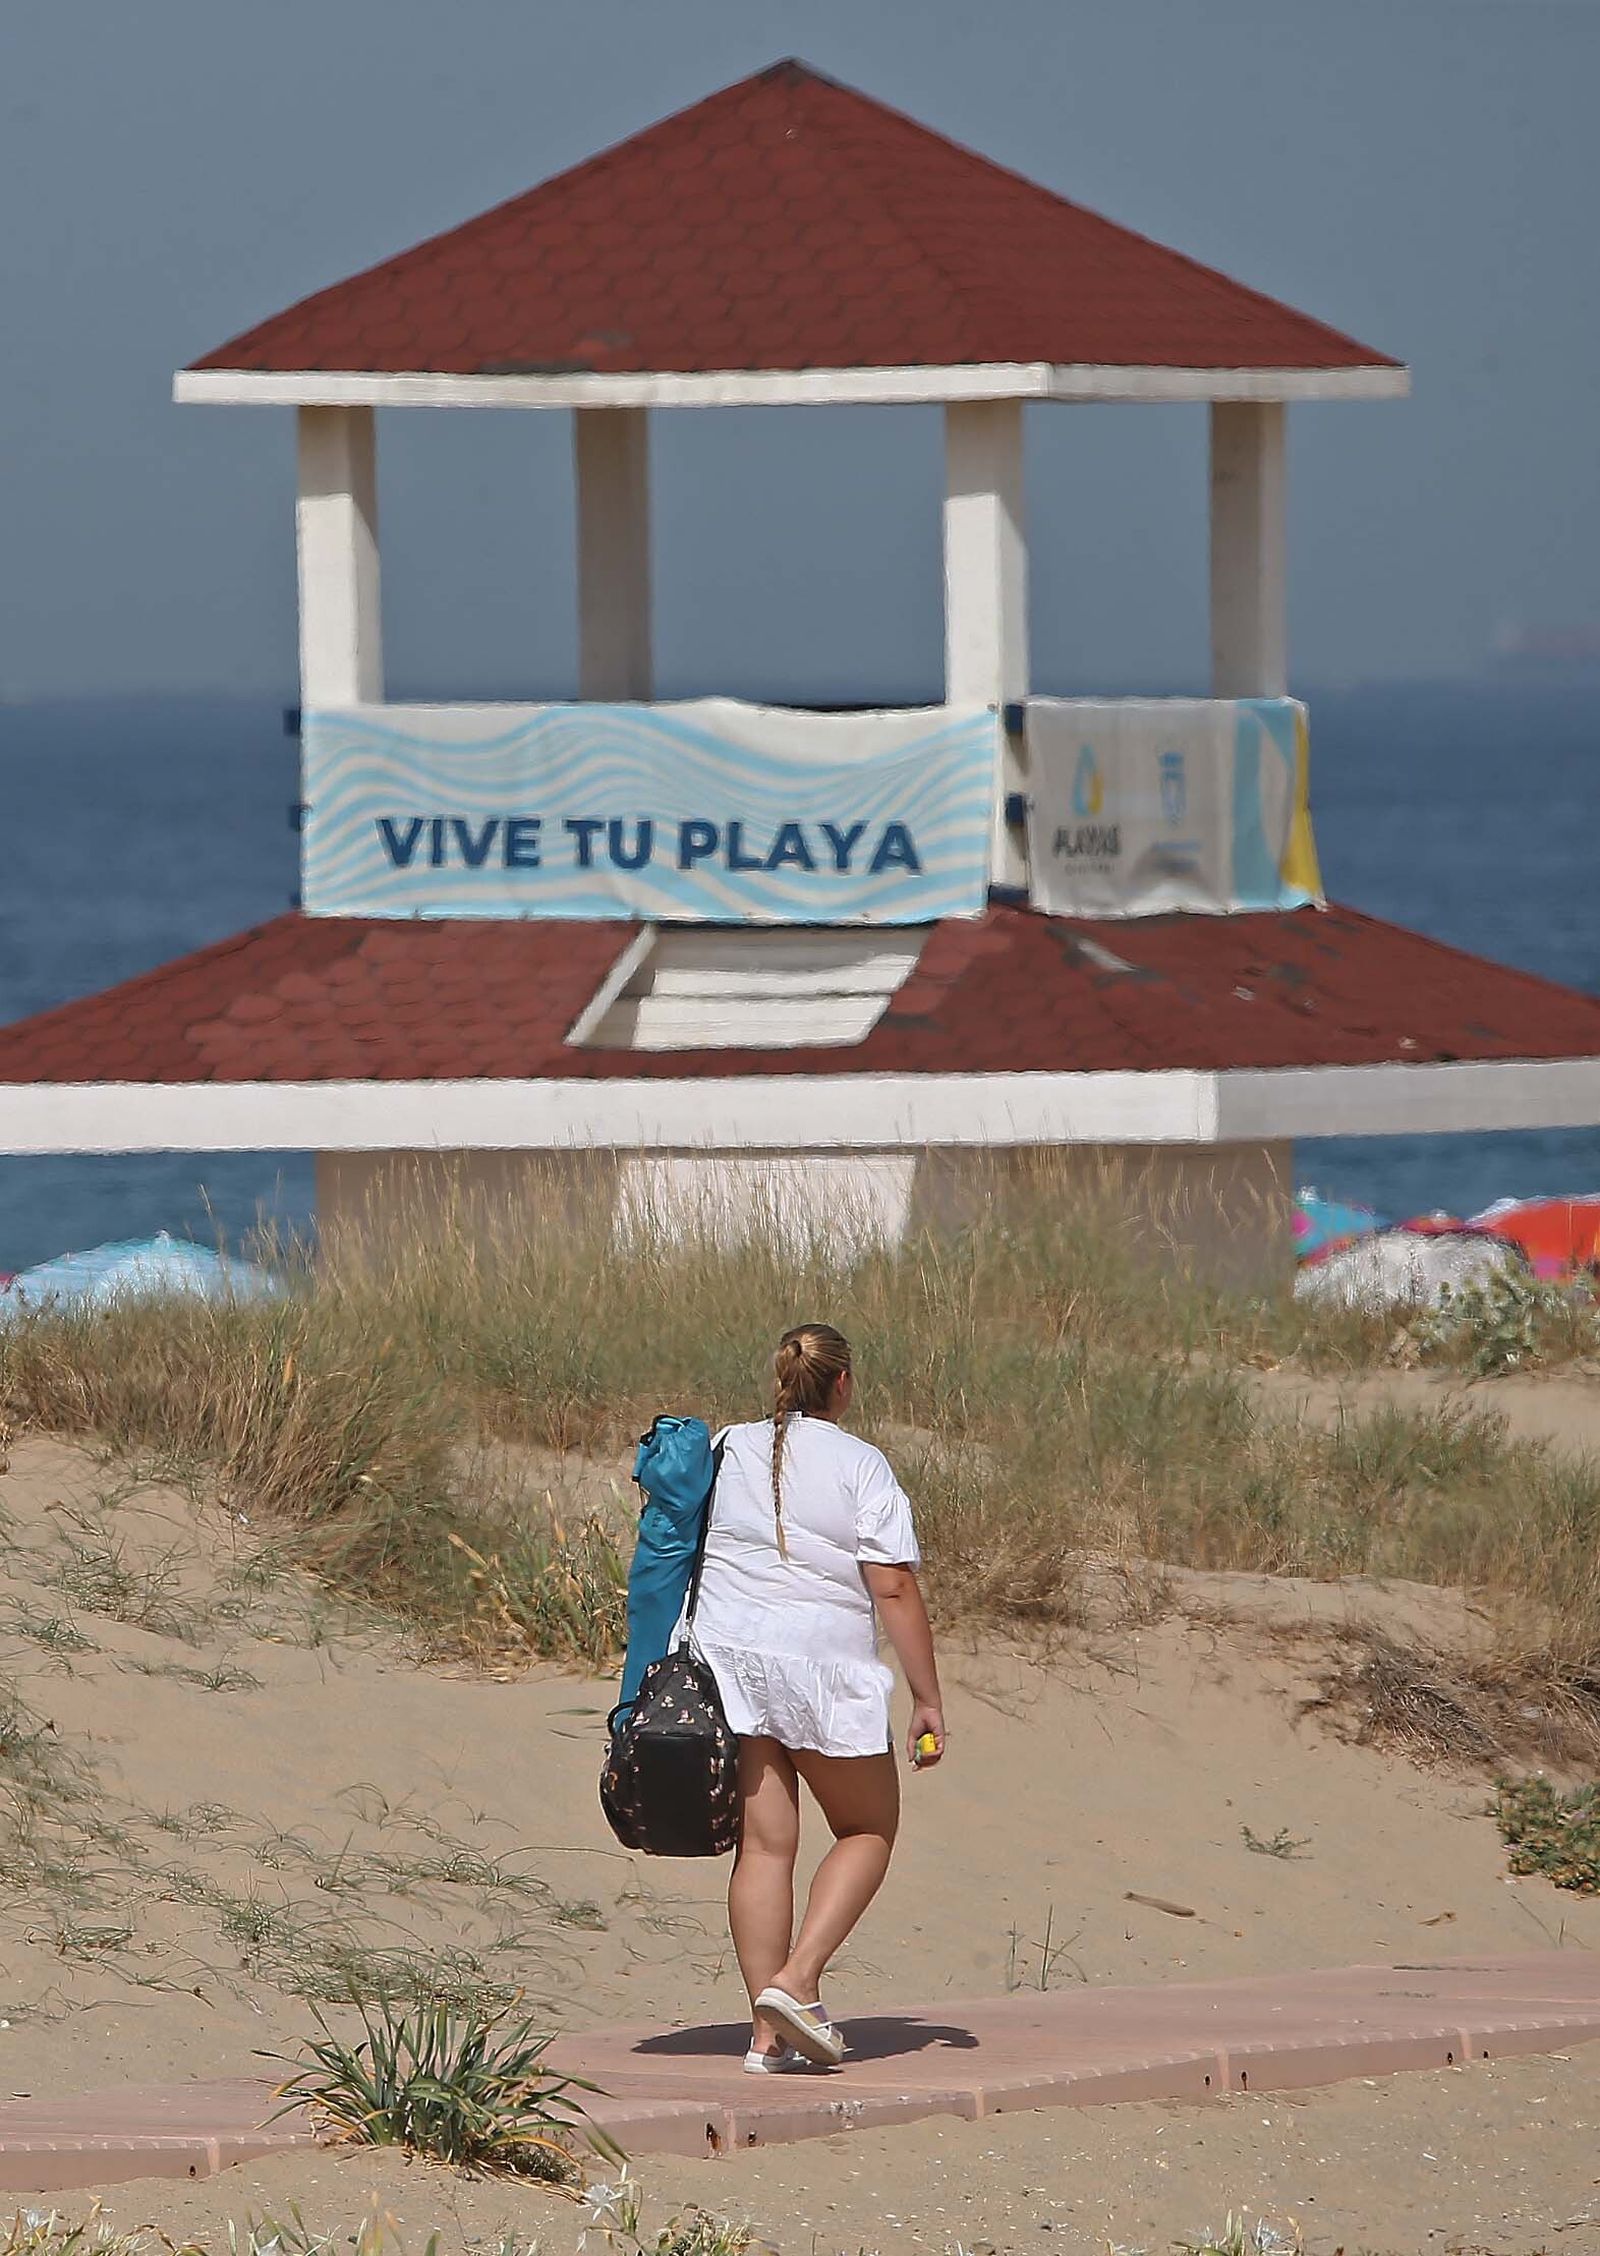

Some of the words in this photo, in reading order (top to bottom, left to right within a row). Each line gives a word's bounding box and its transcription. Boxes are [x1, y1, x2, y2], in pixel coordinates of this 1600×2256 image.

[377, 817, 542, 868] VIVE
[564, 817, 652, 870] TU
[677, 818, 922, 873] PLAYA
